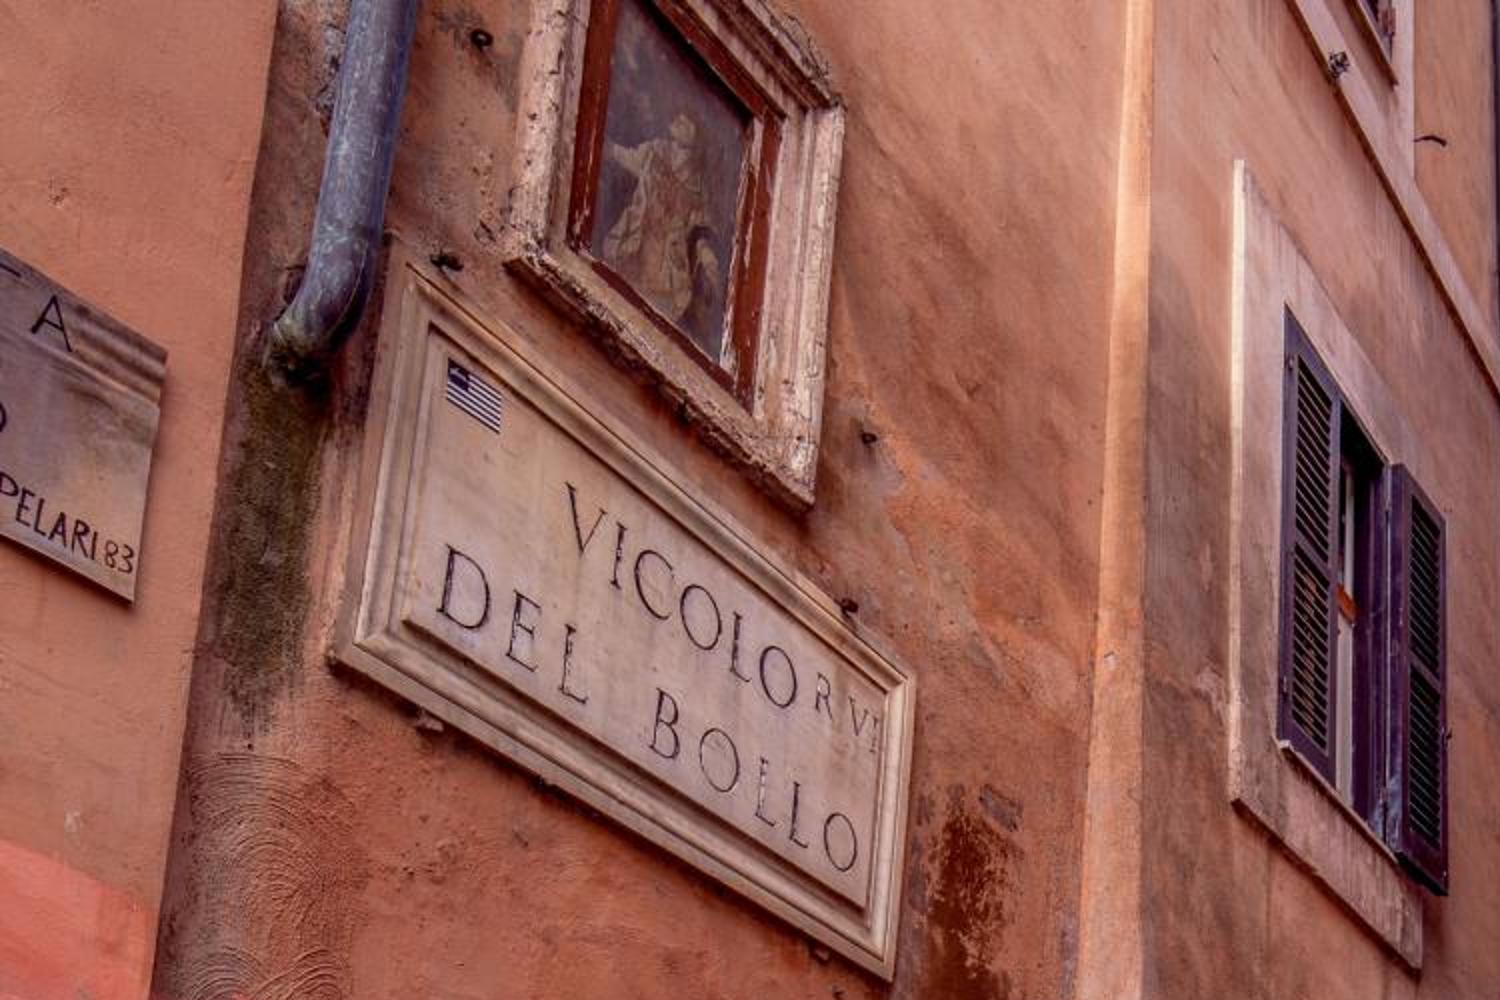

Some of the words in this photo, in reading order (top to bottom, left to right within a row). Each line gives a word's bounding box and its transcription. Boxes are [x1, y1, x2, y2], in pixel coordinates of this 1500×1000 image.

[104, 540, 134, 574] 83
[565, 482, 797, 709] VICOLO
[435, 544, 588, 705] DEL
[648, 687, 857, 873] BOLLO
[815, 671, 833, 720] R
